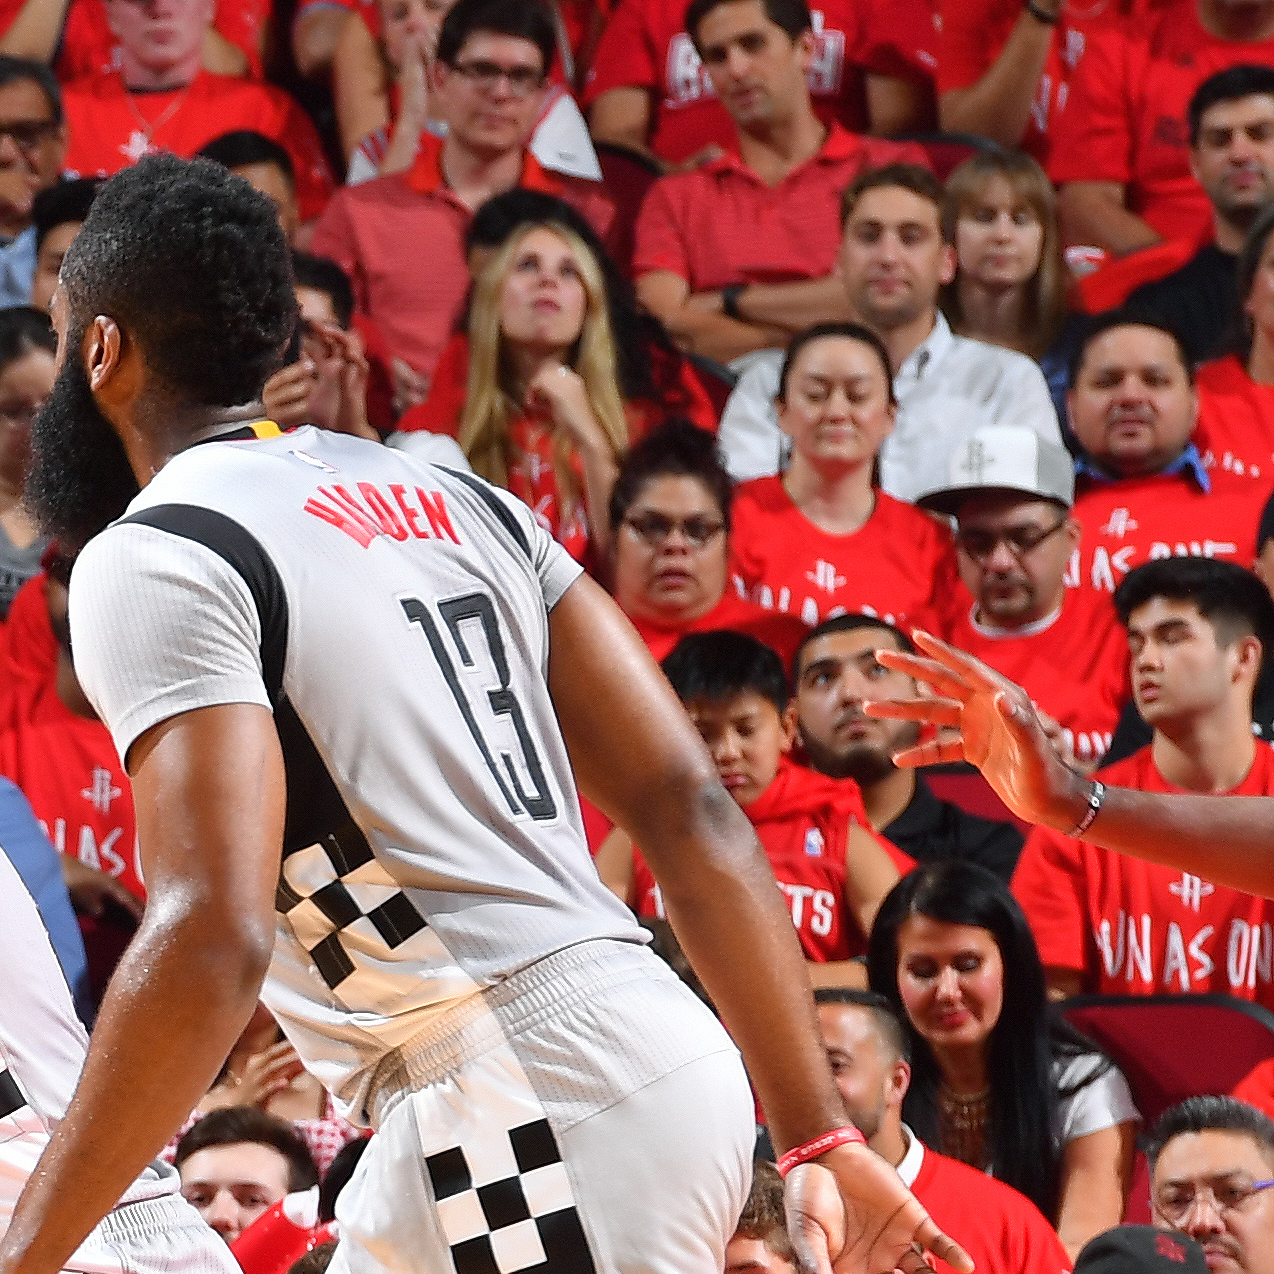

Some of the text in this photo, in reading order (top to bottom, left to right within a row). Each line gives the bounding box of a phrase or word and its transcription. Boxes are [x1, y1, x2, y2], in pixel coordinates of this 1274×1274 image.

[399, 591, 557, 821] 13
[77, 825, 126, 877] AS
[1162, 921, 1214, 992] AS
